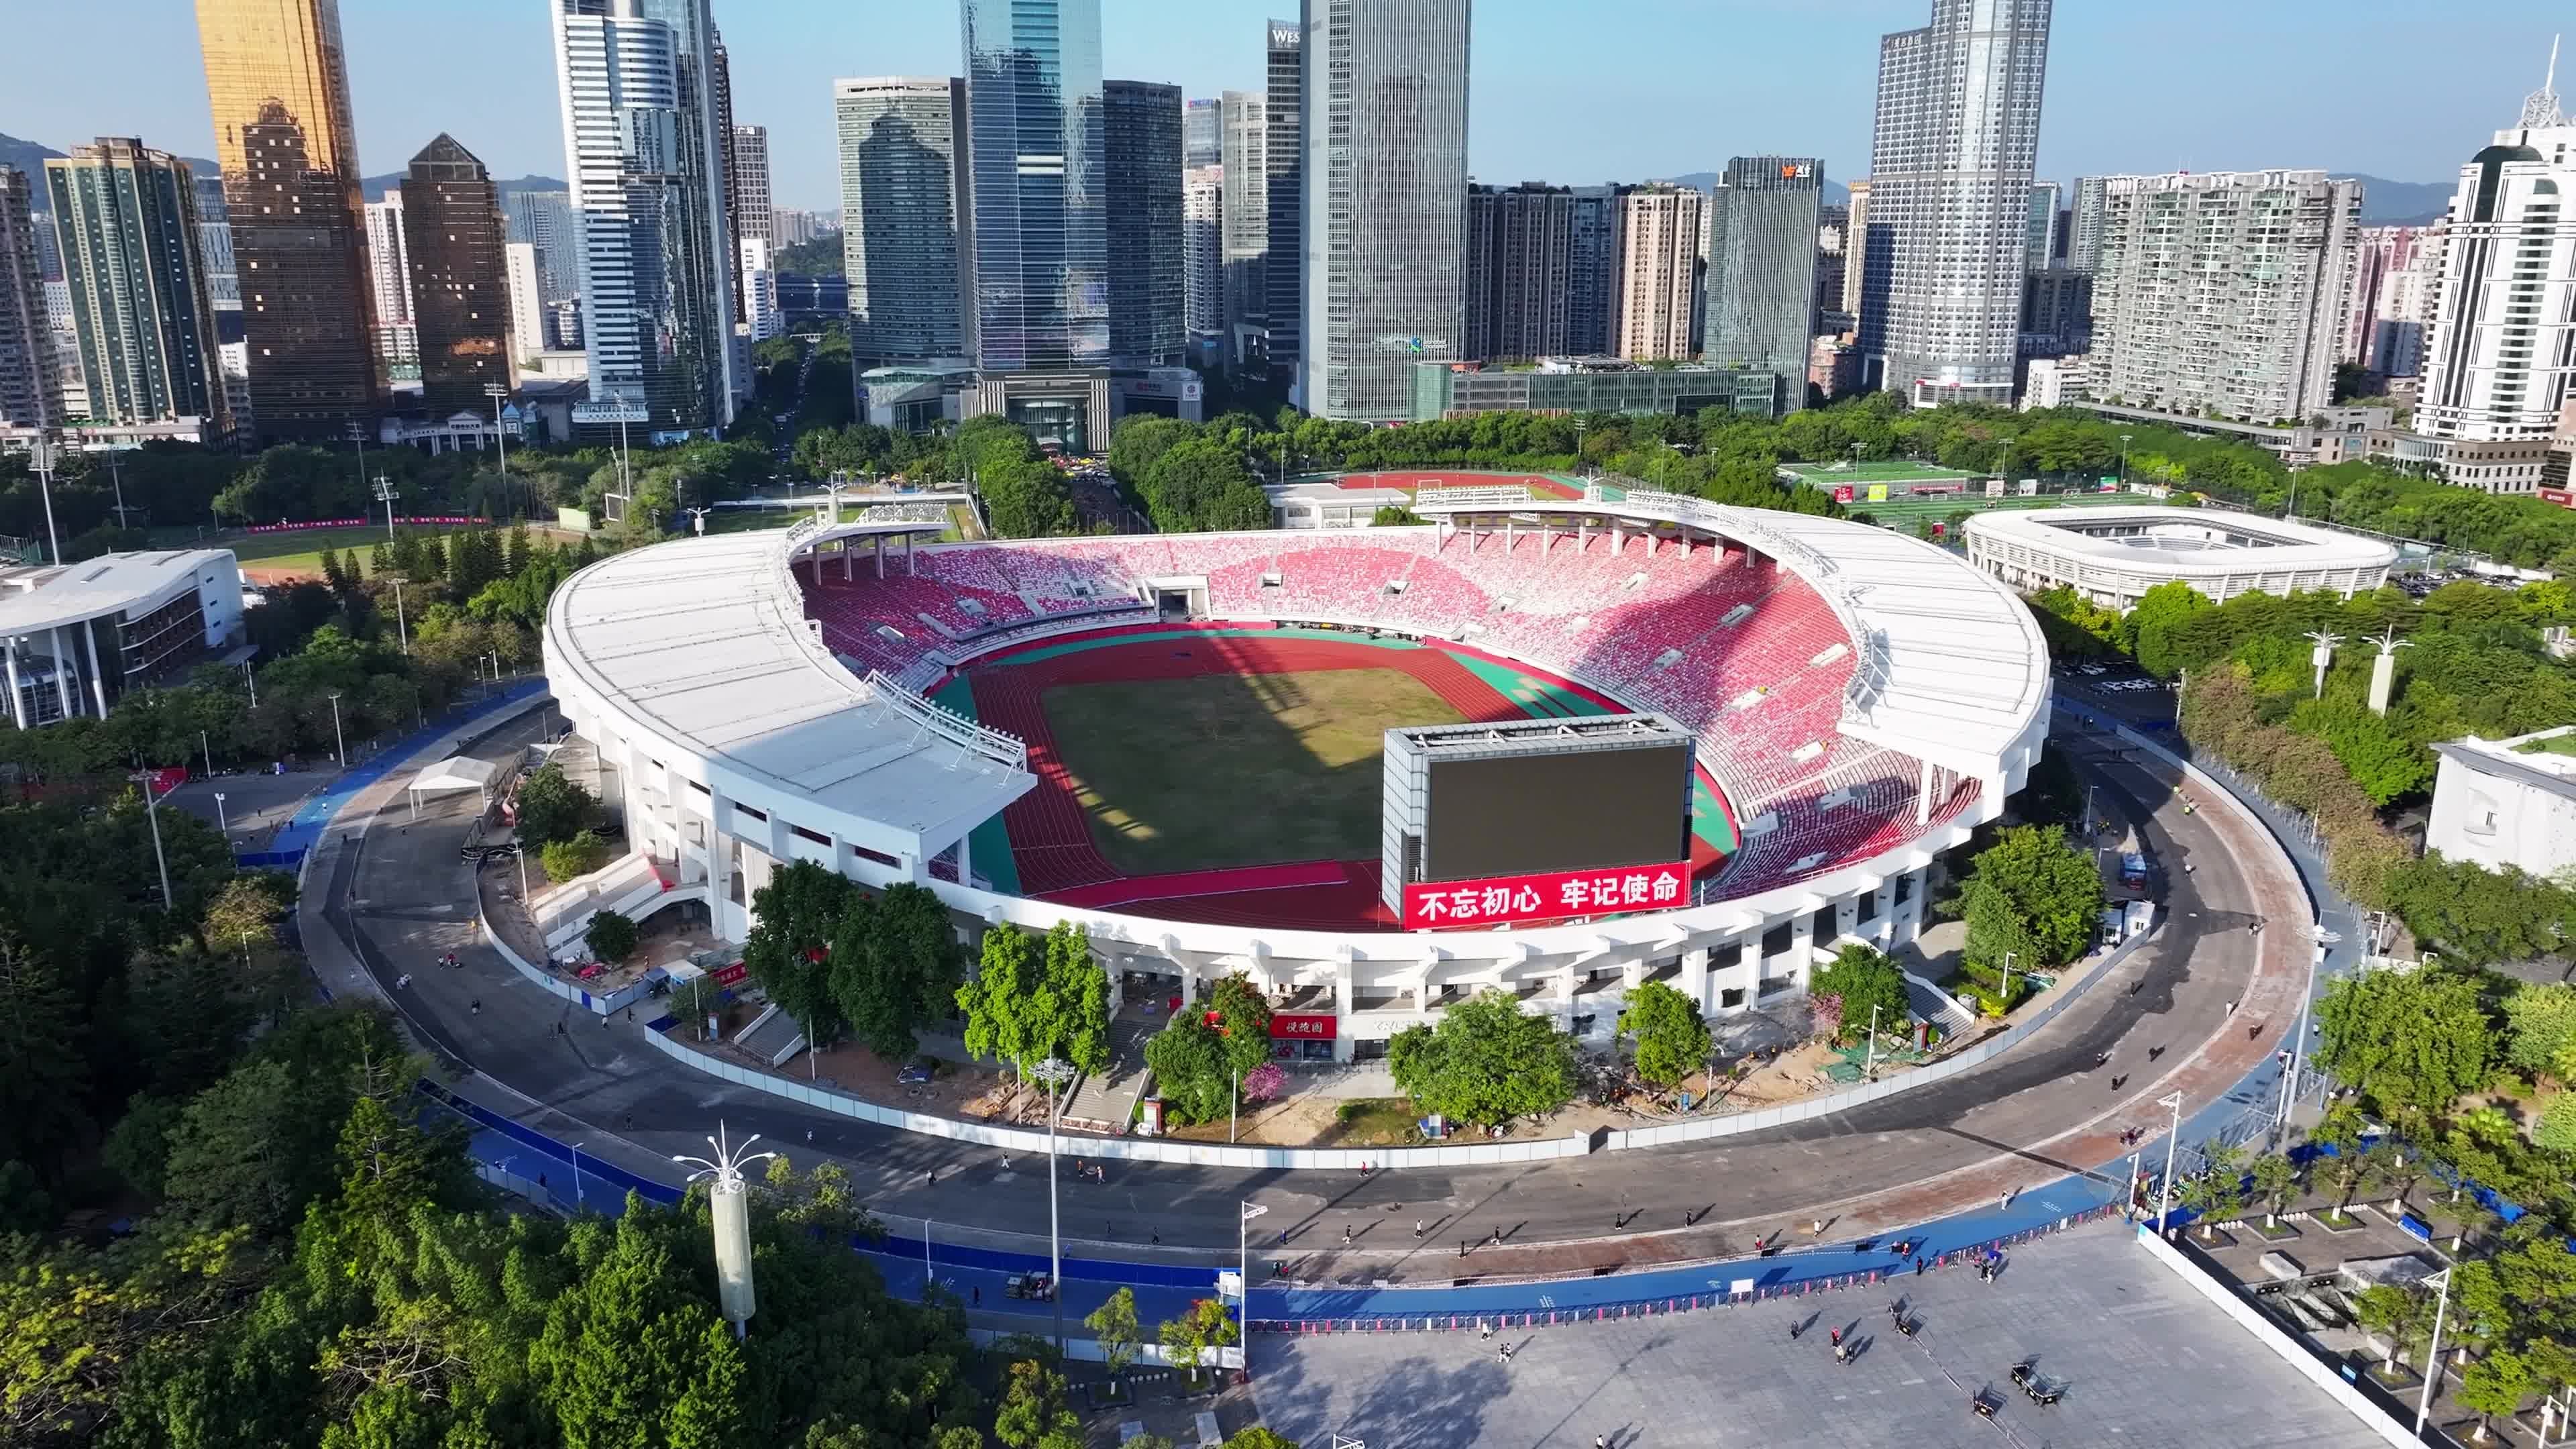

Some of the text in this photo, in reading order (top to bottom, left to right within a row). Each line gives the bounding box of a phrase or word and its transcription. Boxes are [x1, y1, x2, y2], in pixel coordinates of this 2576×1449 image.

[1417, 871, 1680, 922] 不忘初心 牢记使命
